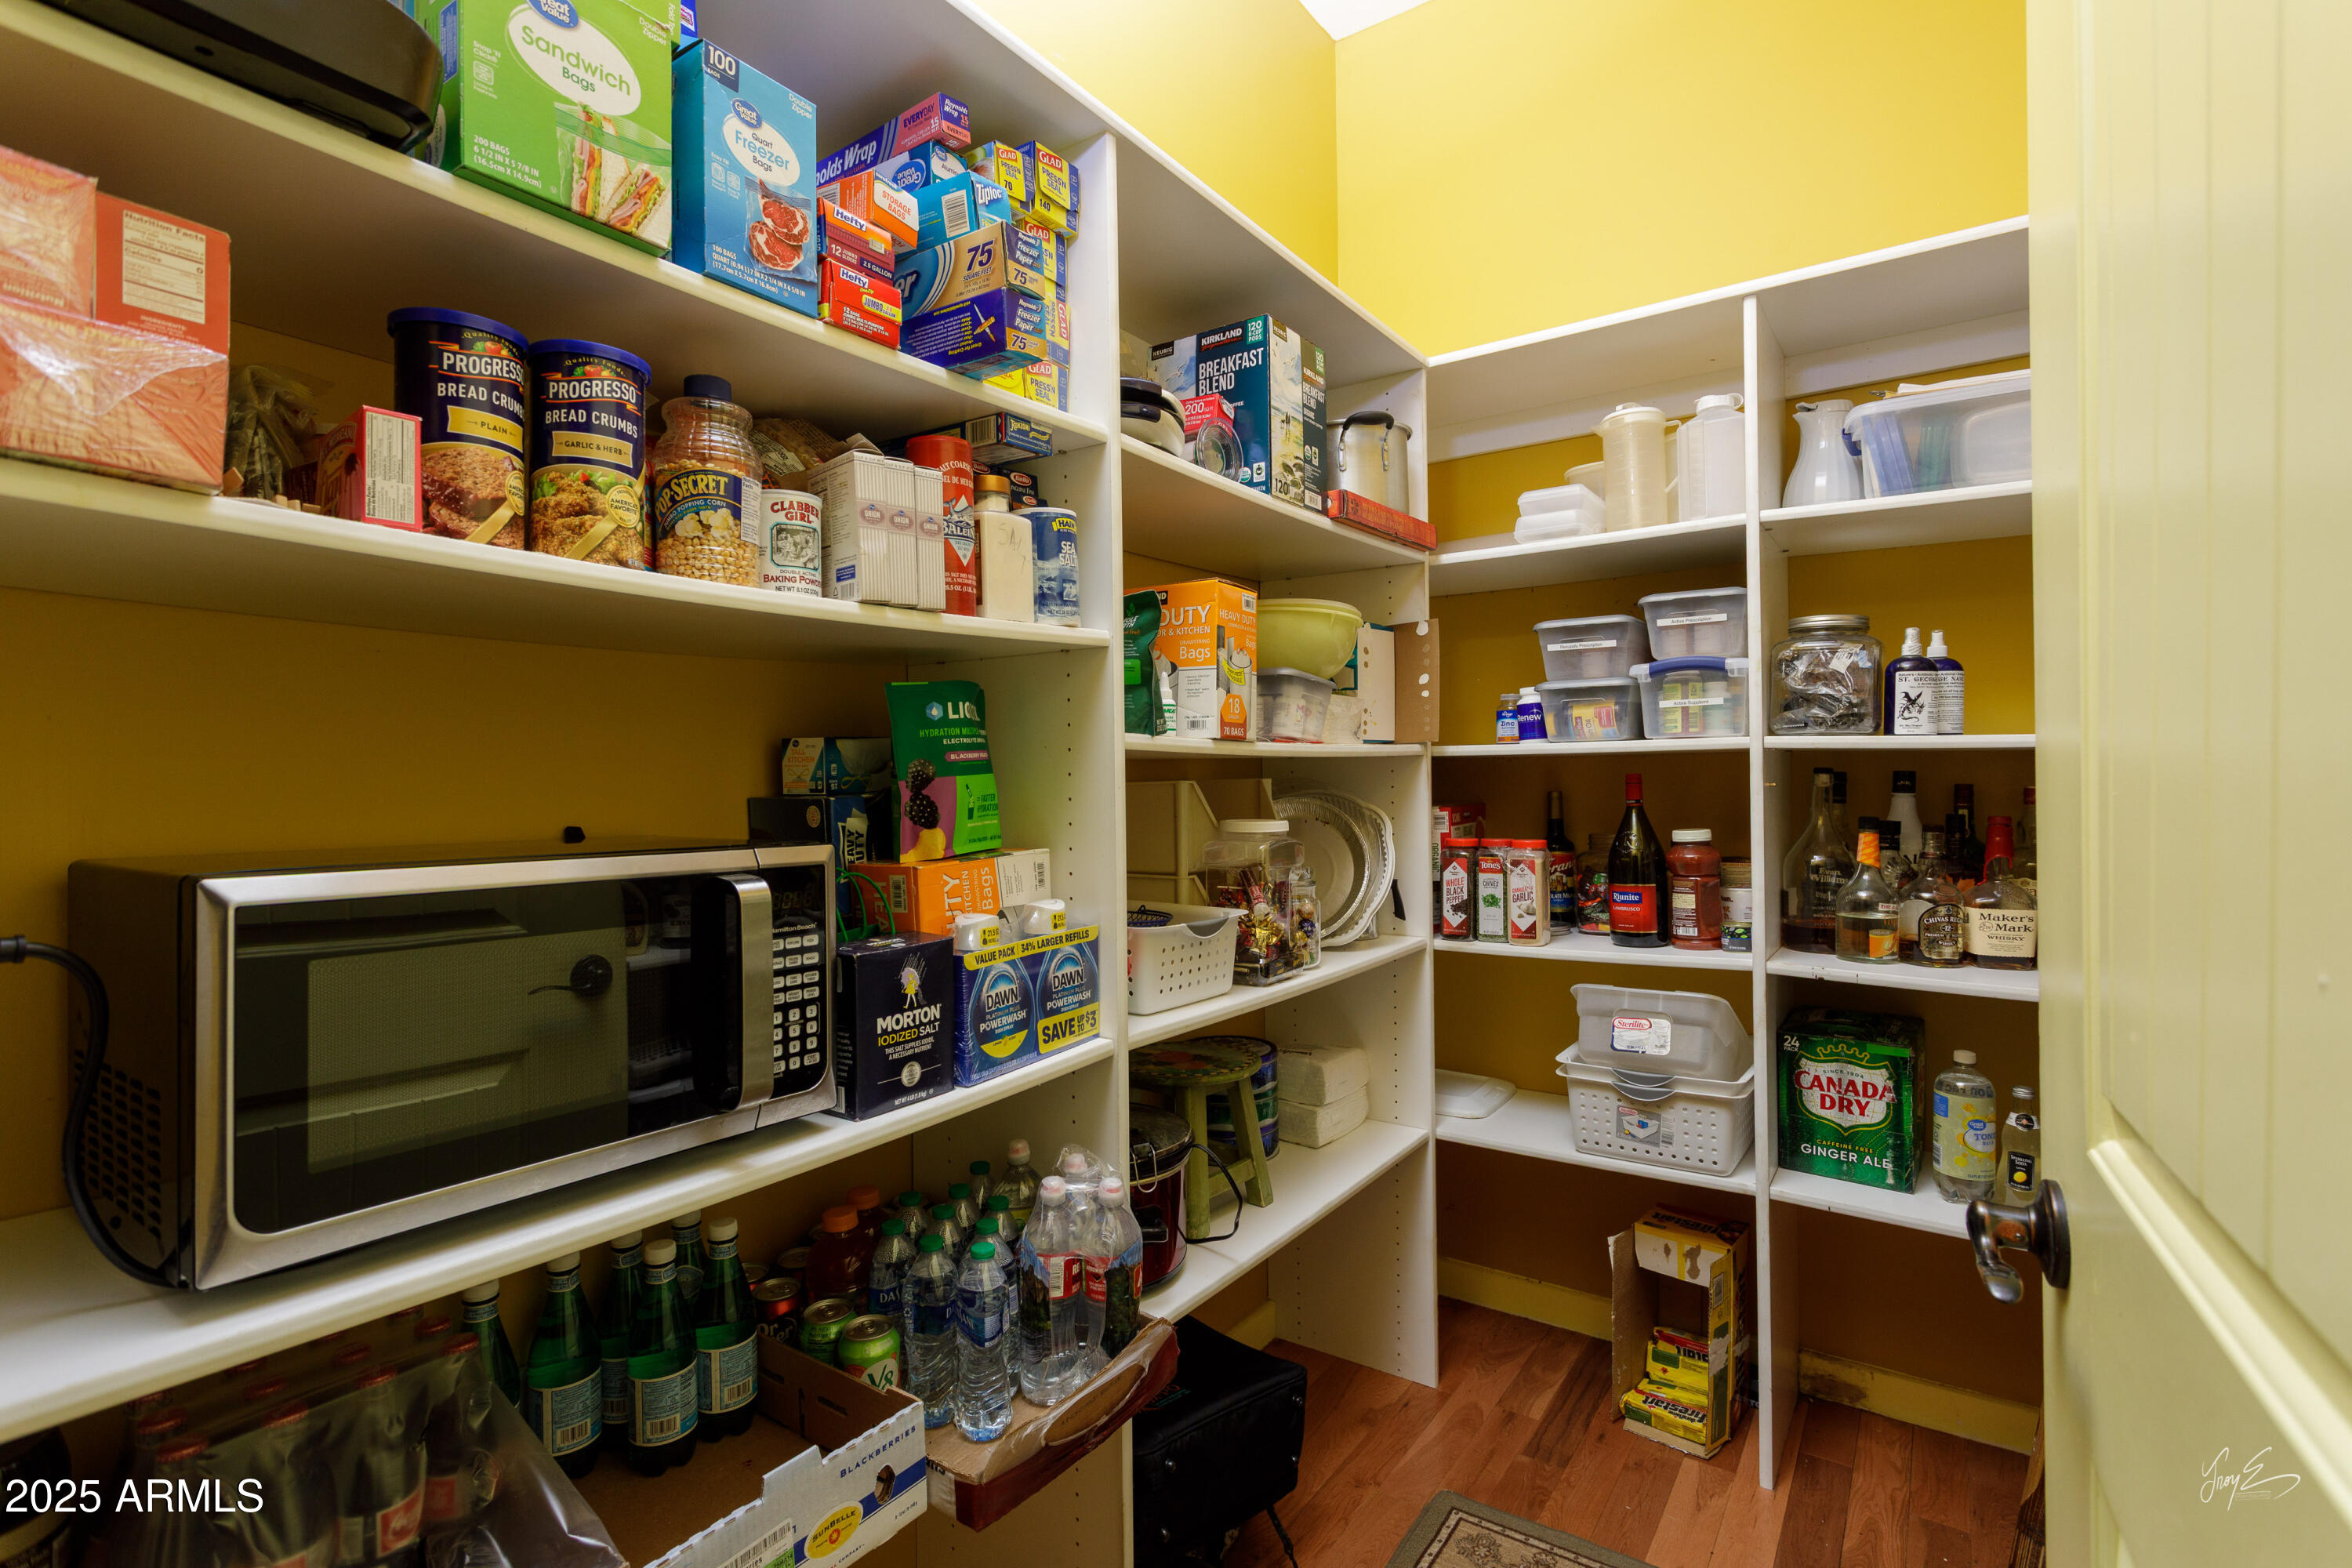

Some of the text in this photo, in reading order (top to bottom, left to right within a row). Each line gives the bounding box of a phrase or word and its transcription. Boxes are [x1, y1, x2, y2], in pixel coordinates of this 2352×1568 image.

[541, 2, 570, 24] Value
[521, 25, 631, 96] Sandwich
[709, 45, 735, 75] 100
[562, 67, 596, 93] Bags
[735, 102, 757, 119] Great
[789, 93, 812, 112] Double
[945, 98, 968, 114] Reynolds
[903, 103, 935, 128] EVERYDAY
[944, 105, 958, 118] Wrap
[931, 117, 939, 128] 15
[474, 135, 510, 155] 200 BAGS
[752, 132, 773, 148] Quart
[735, 129, 789, 170] Freezer
[844, 140, 877, 170] Wrap
[999, 149, 1016, 160] GLAD
[753, 155, 772, 172] Bags
[1039, 151, 1062, 168] GLAD
[1005, 169, 1018, 180] SEAL
[1042, 166, 1066, 190] PRESS'N
[1004, 180, 1012, 191] 70
[1047, 180, 1062, 194] SEAL
[976, 183, 1001, 205] Ziploc
[882, 191, 911, 216] STORAGE
[1040, 198, 1050, 212] 140
[836, 209, 865, 230] Hefty
[887, 204, 906, 220] BAGS
[125, 212, 172, 232] Nutrition
[1018, 232, 1036, 245] Reynolds
[1026, 223, 1049, 239] GLAD
[713, 245, 736, 260] 100 BAGS
[713, 252, 729, 264] QUART
[831, 244, 841, 257] 12
[843, 249, 858, 260] JUMBO
[966, 240, 995, 272] 75
[1018, 242, 1040, 258] Freezer
[1016, 252, 1033, 265] Paper
[841, 269, 867, 288] Hefty
[872, 263, 892, 278] GALLON
[1014, 267, 1027, 285] 75
[864, 297, 883, 312] JUMBO
[1017, 309, 1041, 323] Freezer
[1058, 304, 1067, 337] GLAD
[1015, 318, 1033, 332] Paper
[1248, 321, 1262, 331] 120
[1011, 333, 1027, 350] 75
[1201, 328, 1243, 346] KIRKLAND
[1248, 334, 1262, 343] PODS
[1152, 347, 1173, 357] KEURIG
[1029, 365, 1051, 374] GLAD
[1199, 348, 1264, 380] BREAKFAST
[1303, 367, 1323, 385] KIRKLAND
[437, 383, 487, 401] BREAD
[550, 380, 637, 404] PROGRESSO
[1199, 372, 1235, 397] BLEND
[1036, 388, 1051, 401] SEAL
[1303, 381, 1325, 405] BREAKFAST
[1303, 393, 1316, 409] BLEND
[1185, 401, 1204, 416] 200
[481, 421, 507, 434] PLAIN
[546, 409, 637, 438] BREAD CRUMBS
[564, 441, 622, 456] GARLIC HERB
[1275, 477, 1289, 495] 120
[610, 504, 638, 516] FAVORITE
[677, 499, 705, 512] POPPING
[771, 501, 819, 521] CLABBER
[785, 511, 811, 524] GIRL
[1061, 541, 1075, 554] SEA
[764, 574, 797, 583] BAKING
[1162, 605, 1210, 626] DUTY
[1219, 608, 1256, 626] HEAVY DUTY
[1176, 626, 1210, 636] KITCHEN
[1179, 646, 1210, 662] Bags
[1229, 698, 1240, 714] 18
[1518, 713, 1541, 722] Renew
[920, 728, 960, 738] HYDRATION
[1231, 728, 1244, 736] BAGS
[1446, 877, 1465, 887] WHOLE
[1810, 874, 1849, 884] Williams
[980, 867, 994, 910] Bags
[1446, 887, 1465, 896] BLACK
[1446, 895, 1464, 904] PEPPER
[1512, 891, 1533, 903] GARLIC
[1613, 892, 1639, 902] Riunite
[1979, 913, 2034, 922] Maker's
[1995, 924, 2032, 932] Mark
[975, 930, 1090, 965] VALUE PACK 34% LARGER REFILLS
[1052, 967, 1084, 992] DAWN
[985, 985, 1019, 1012] DAWN
[1047, 990, 1091, 1011] POWERWASH
[1052, 989, 1075, 1000] PLATINUM
[877, 1004, 940, 1034] MORTON
[980, 1010, 1026, 1033] POWERWASH
[985, 1008, 1009, 1020] PLATINUM
[1042, 1011, 1097, 1044] SAVE UP TO $3
[1616, 1019, 1647, 1029] Sterilite
[878, 1022, 940, 1047] IODIZED SALT
[1783, 1035, 1800, 1047] 24
[904, 1040, 921, 1051] SUPPLIES
[893, 1050, 914, 1059] NECESSARY
[1794, 1070, 1897, 1104] CANADA
[1819, 1093, 1870, 1117] DRY
[1817, 1138, 1875, 1154] CAFFEINE FREE
[1801, 1143, 1891, 1170] GINGER ALE
[2010, 1155, 2032, 1163] SPARKLING
[867, 1364, 894, 1390] V8
[840, 1425, 916, 1479] BLACKBERRIES
[812, 1510, 857, 1543] SUNBELLE
[838, 1545, 863, 1563] COMPANY
